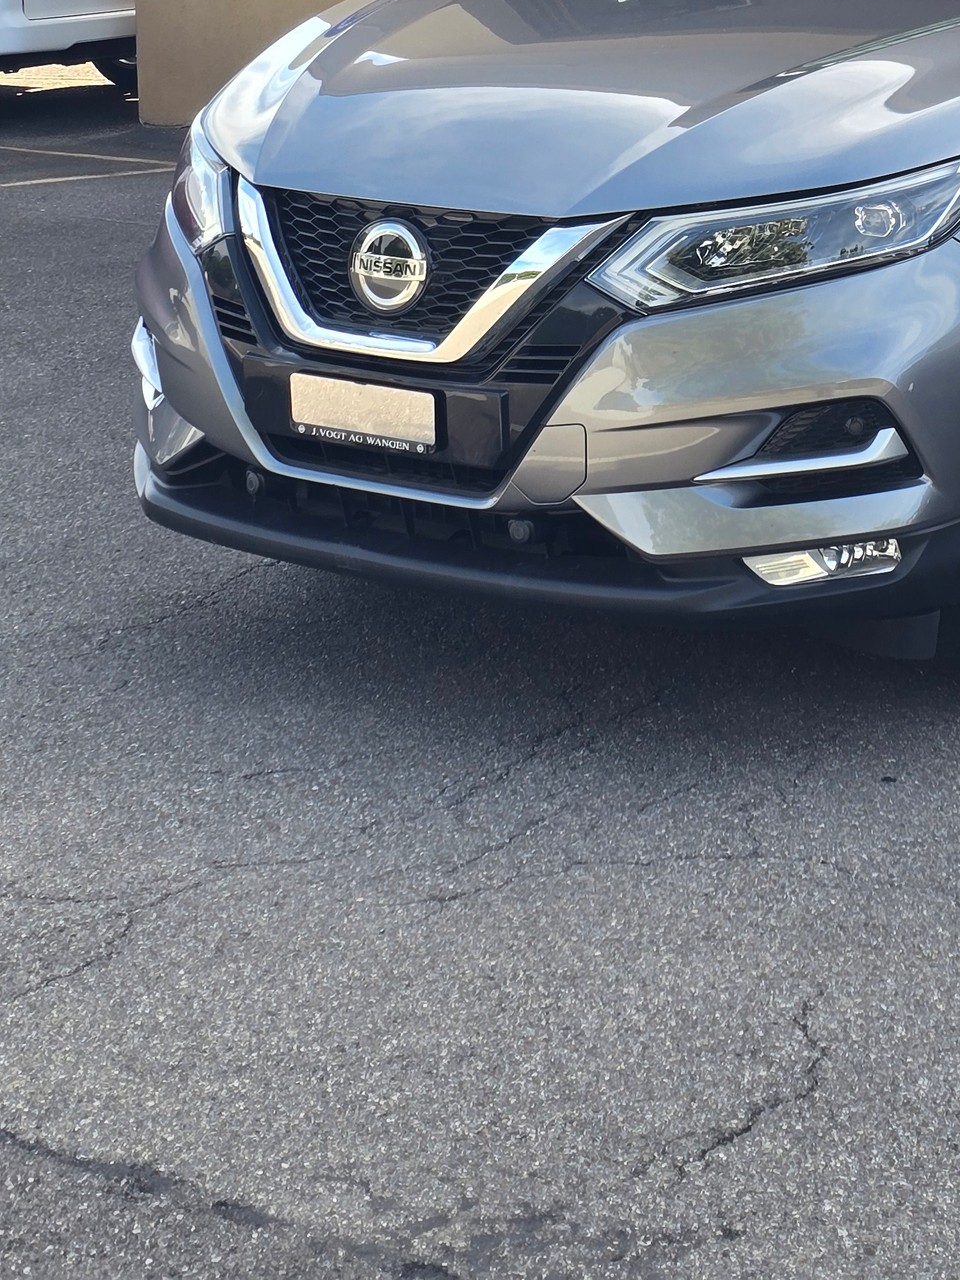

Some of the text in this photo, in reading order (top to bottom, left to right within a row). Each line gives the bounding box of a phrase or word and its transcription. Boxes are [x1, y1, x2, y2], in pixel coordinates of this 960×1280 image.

[359, 258, 417, 276] NISSAN
[348, 434, 363, 443] AG
[366, 436, 410, 451] WANGEN
